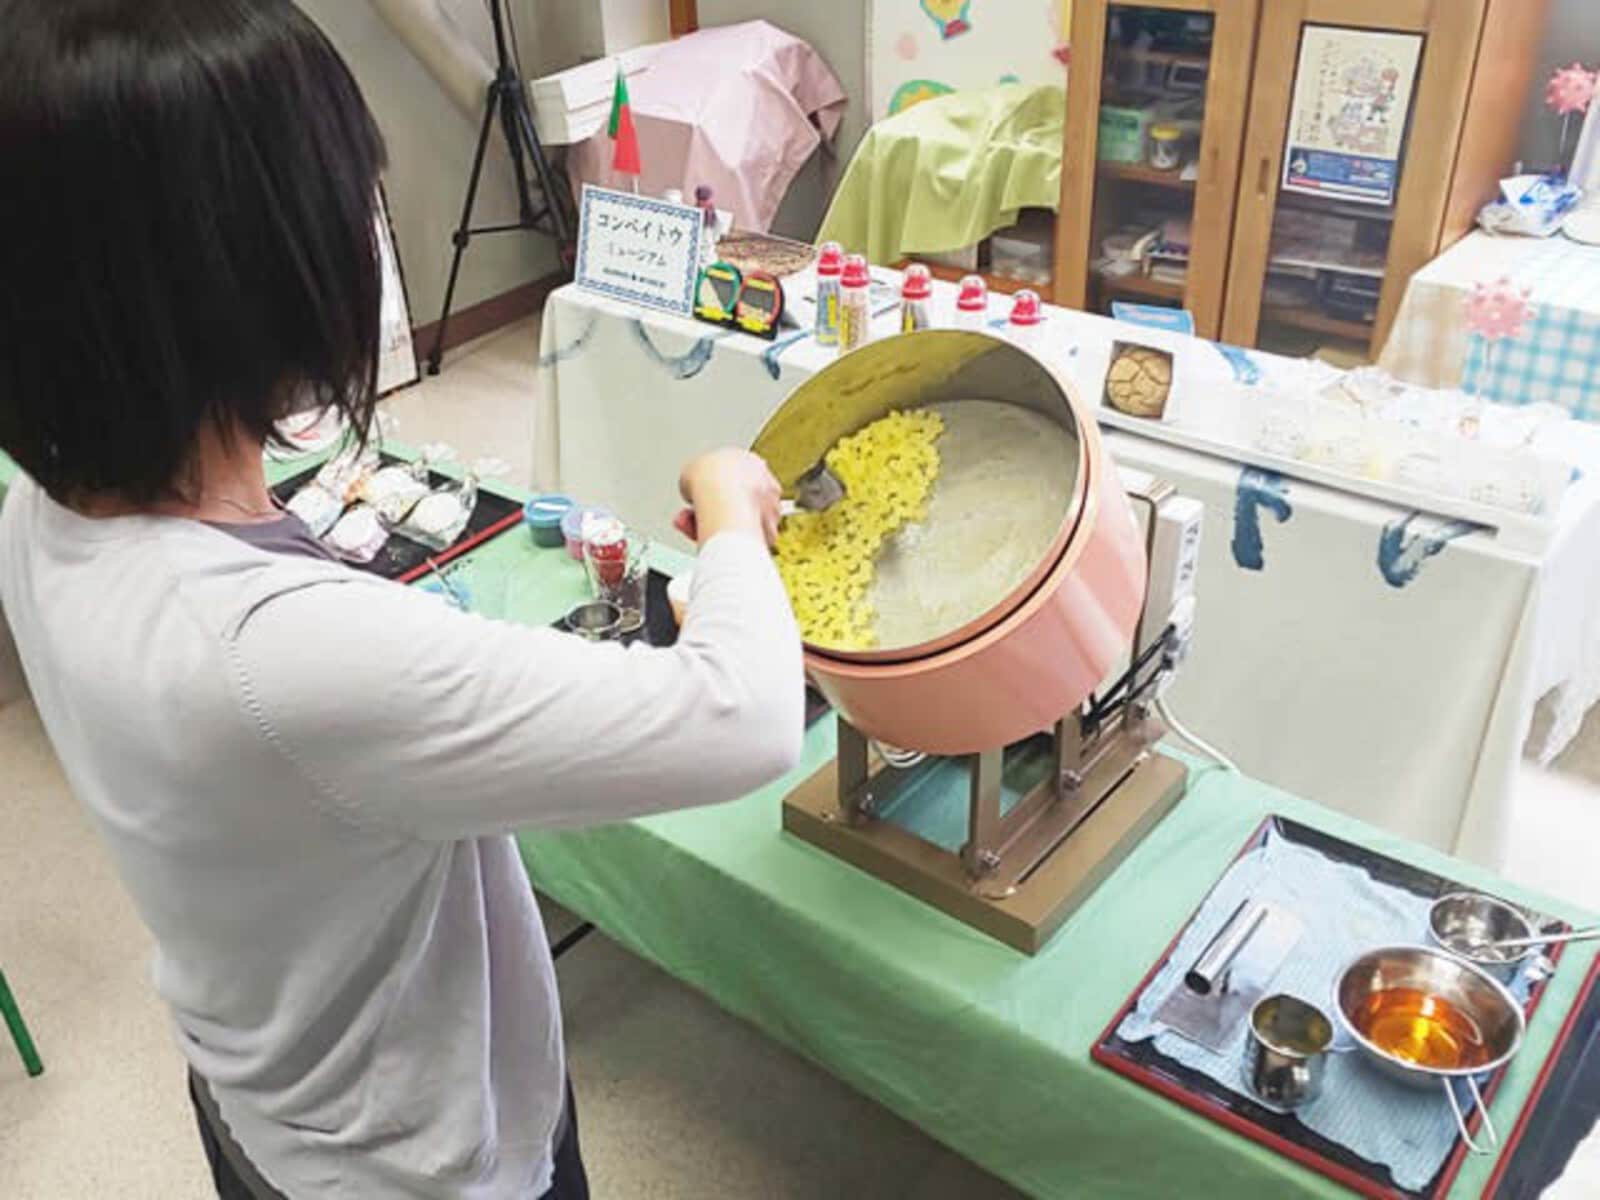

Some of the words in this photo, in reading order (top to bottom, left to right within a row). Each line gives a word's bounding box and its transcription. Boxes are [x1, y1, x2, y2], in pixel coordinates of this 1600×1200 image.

[597, 213, 683, 246] コンペイトウ
